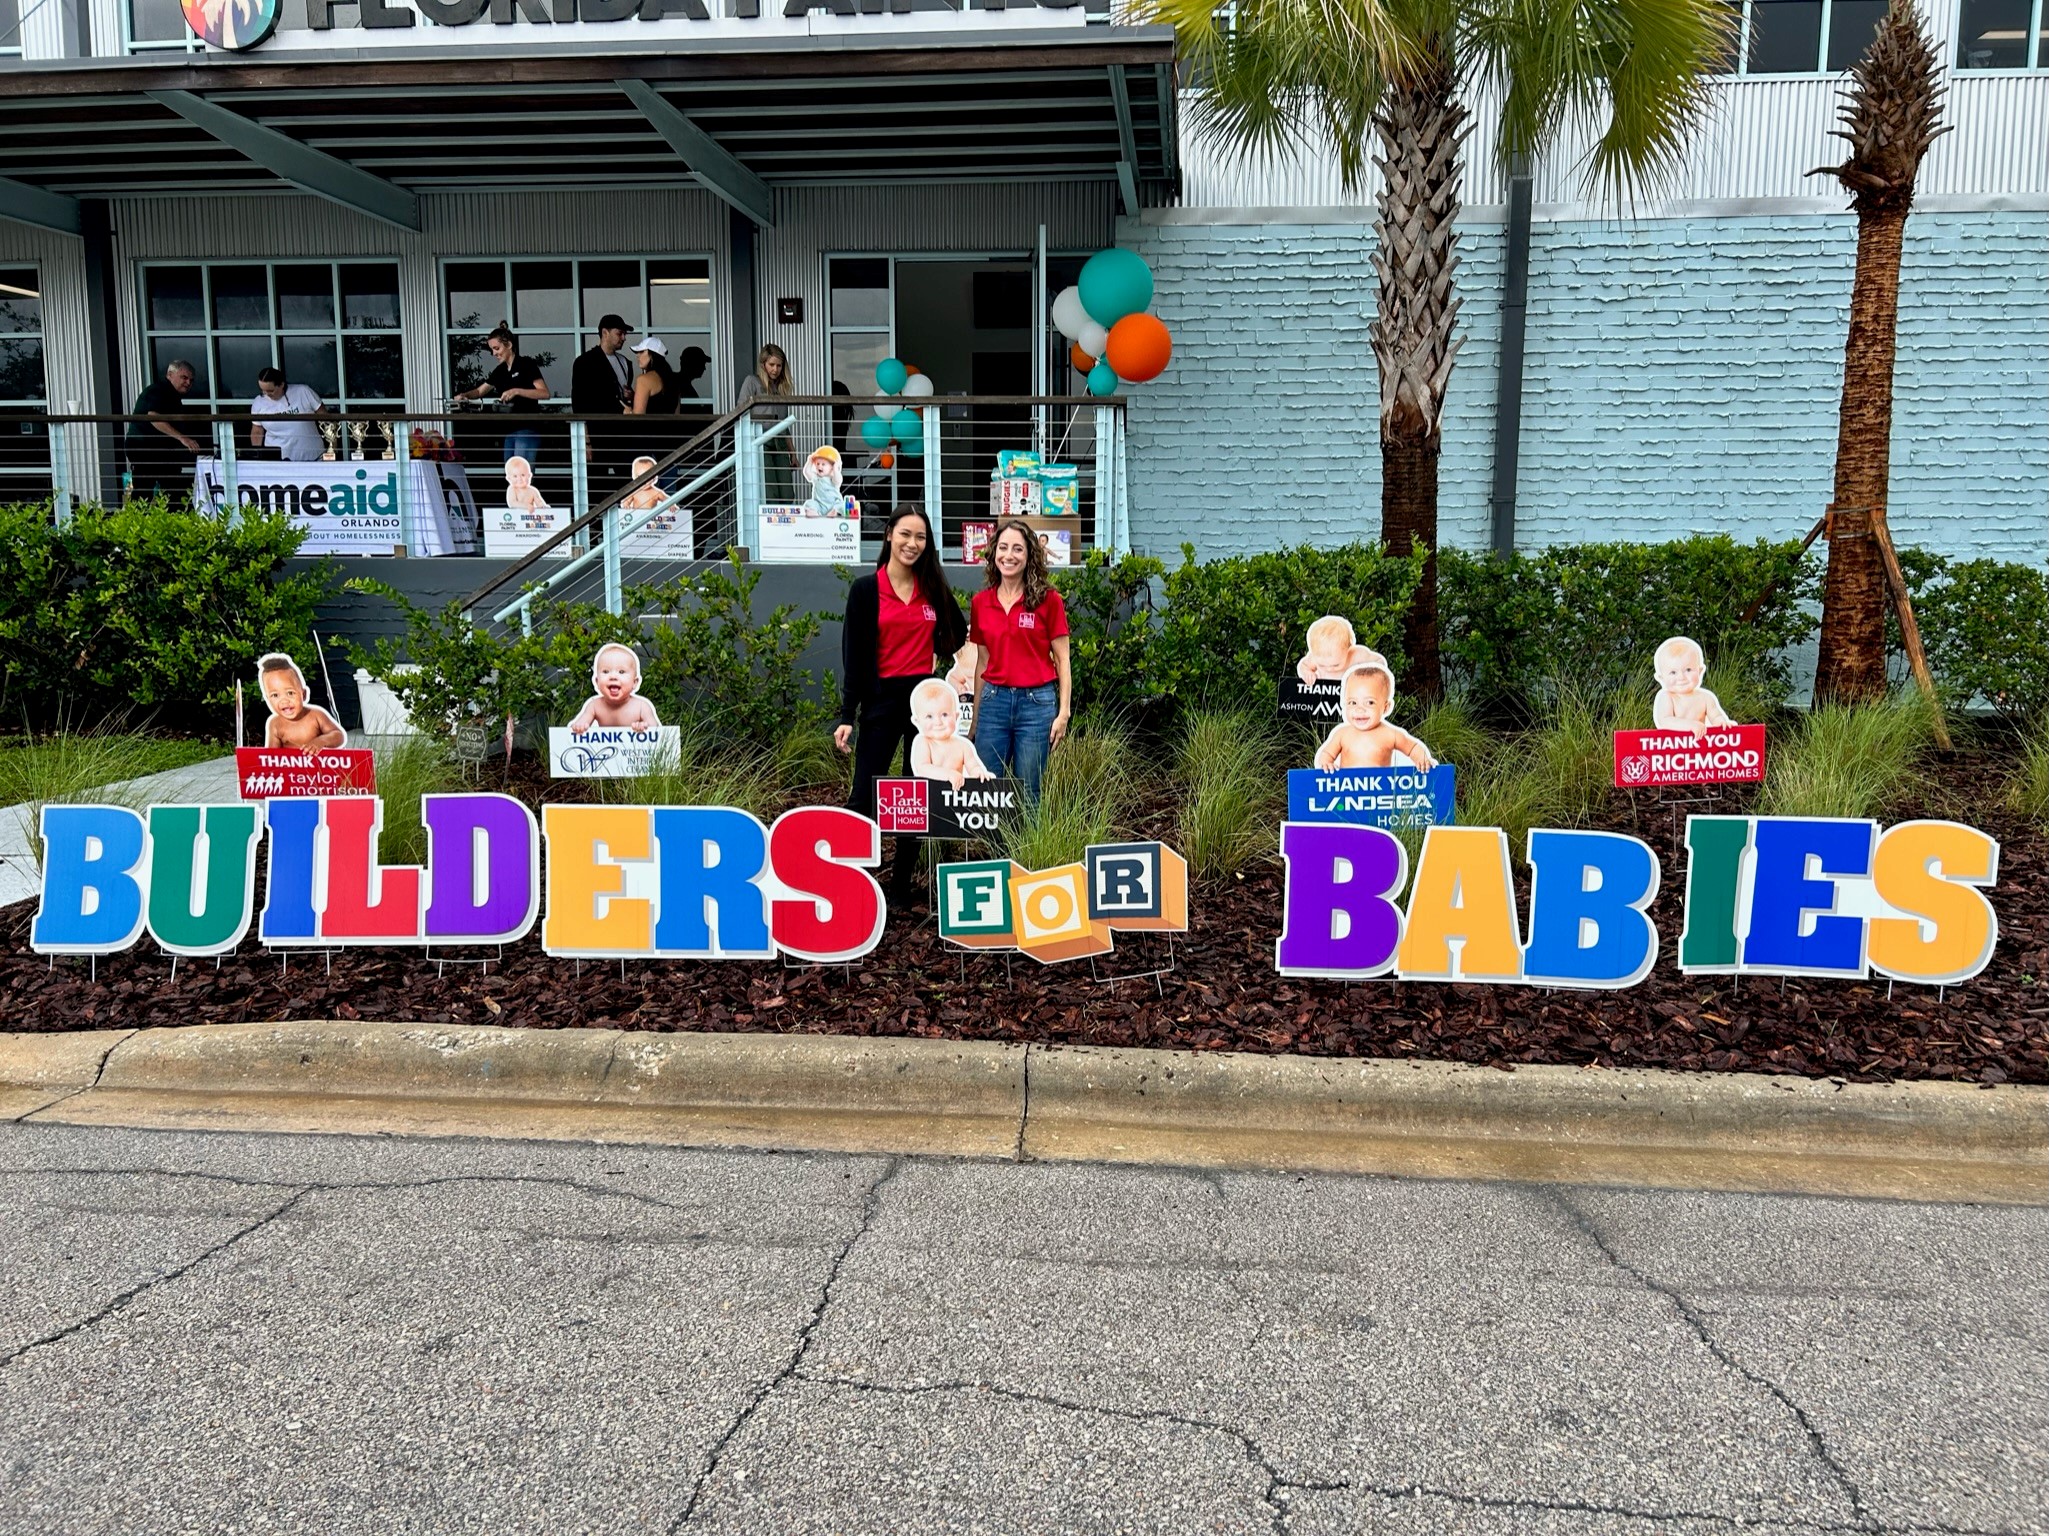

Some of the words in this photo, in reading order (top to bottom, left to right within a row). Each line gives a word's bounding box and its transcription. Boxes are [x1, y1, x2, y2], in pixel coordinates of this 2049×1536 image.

[341, 519, 400, 527] ORLANDO
[1297, 683, 1341, 696] THANK
[1280, 703, 1313, 712] ASHTON
[571, 732, 624, 743] THANK
[627, 731, 659, 743] YOU
[1640, 735, 1701, 751] THANK
[1704, 733, 1742, 747] YOU
[258, 755, 315, 768] THANK
[317, 756, 352, 769] YOU
[1651, 750, 1760, 772] RICHMOND
[288, 772, 340, 786] taylor
[1652, 770, 1715, 782] AMERICAN
[1717, 767, 1759, 780] HOMES
[289, 784, 370, 796] morrison
[1315, 776, 1383, 793] THANK
[1386, 775, 1428, 790] YOU
[892, 787, 923, 807] Park
[941, 790, 1015, 808] THANK
[878, 797, 928, 816] Square
[897, 816, 925, 825] HOMES
[955, 812, 999, 830] YOU
[33, 796, 881, 956] BUILDERS
[956, 858, 1150, 931] FOR
[1278, 819, 1994, 981] BABIES
